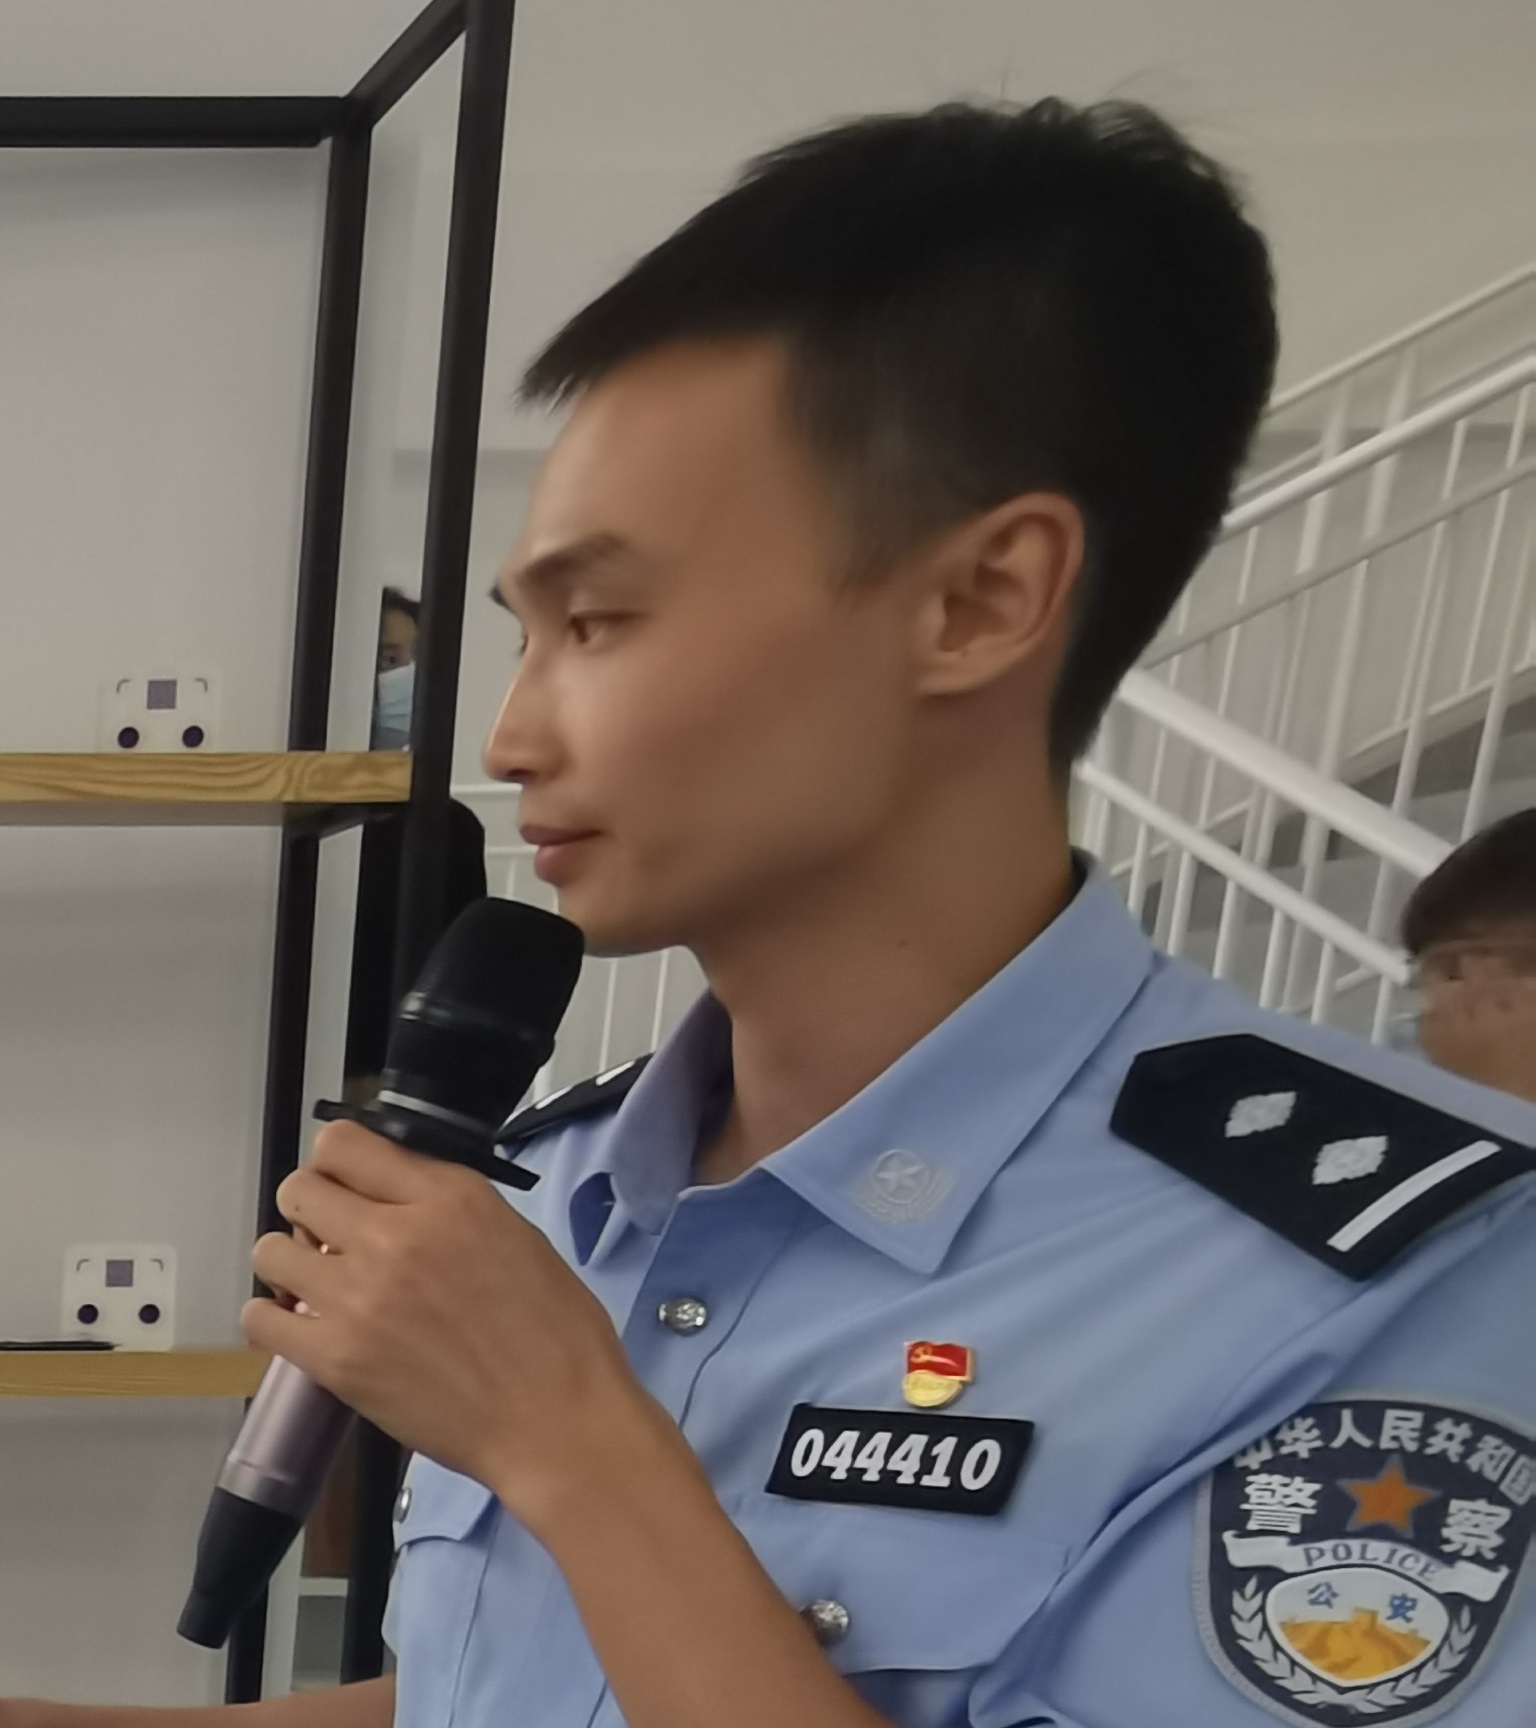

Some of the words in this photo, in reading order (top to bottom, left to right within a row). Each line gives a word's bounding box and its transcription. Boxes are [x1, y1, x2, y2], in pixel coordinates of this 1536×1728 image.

[790, 1427, 1003, 1491] 044410
[1233, 1408, 1534, 1506] 中华人民共和国
[1303, 1545, 1441, 1583] POLICE
